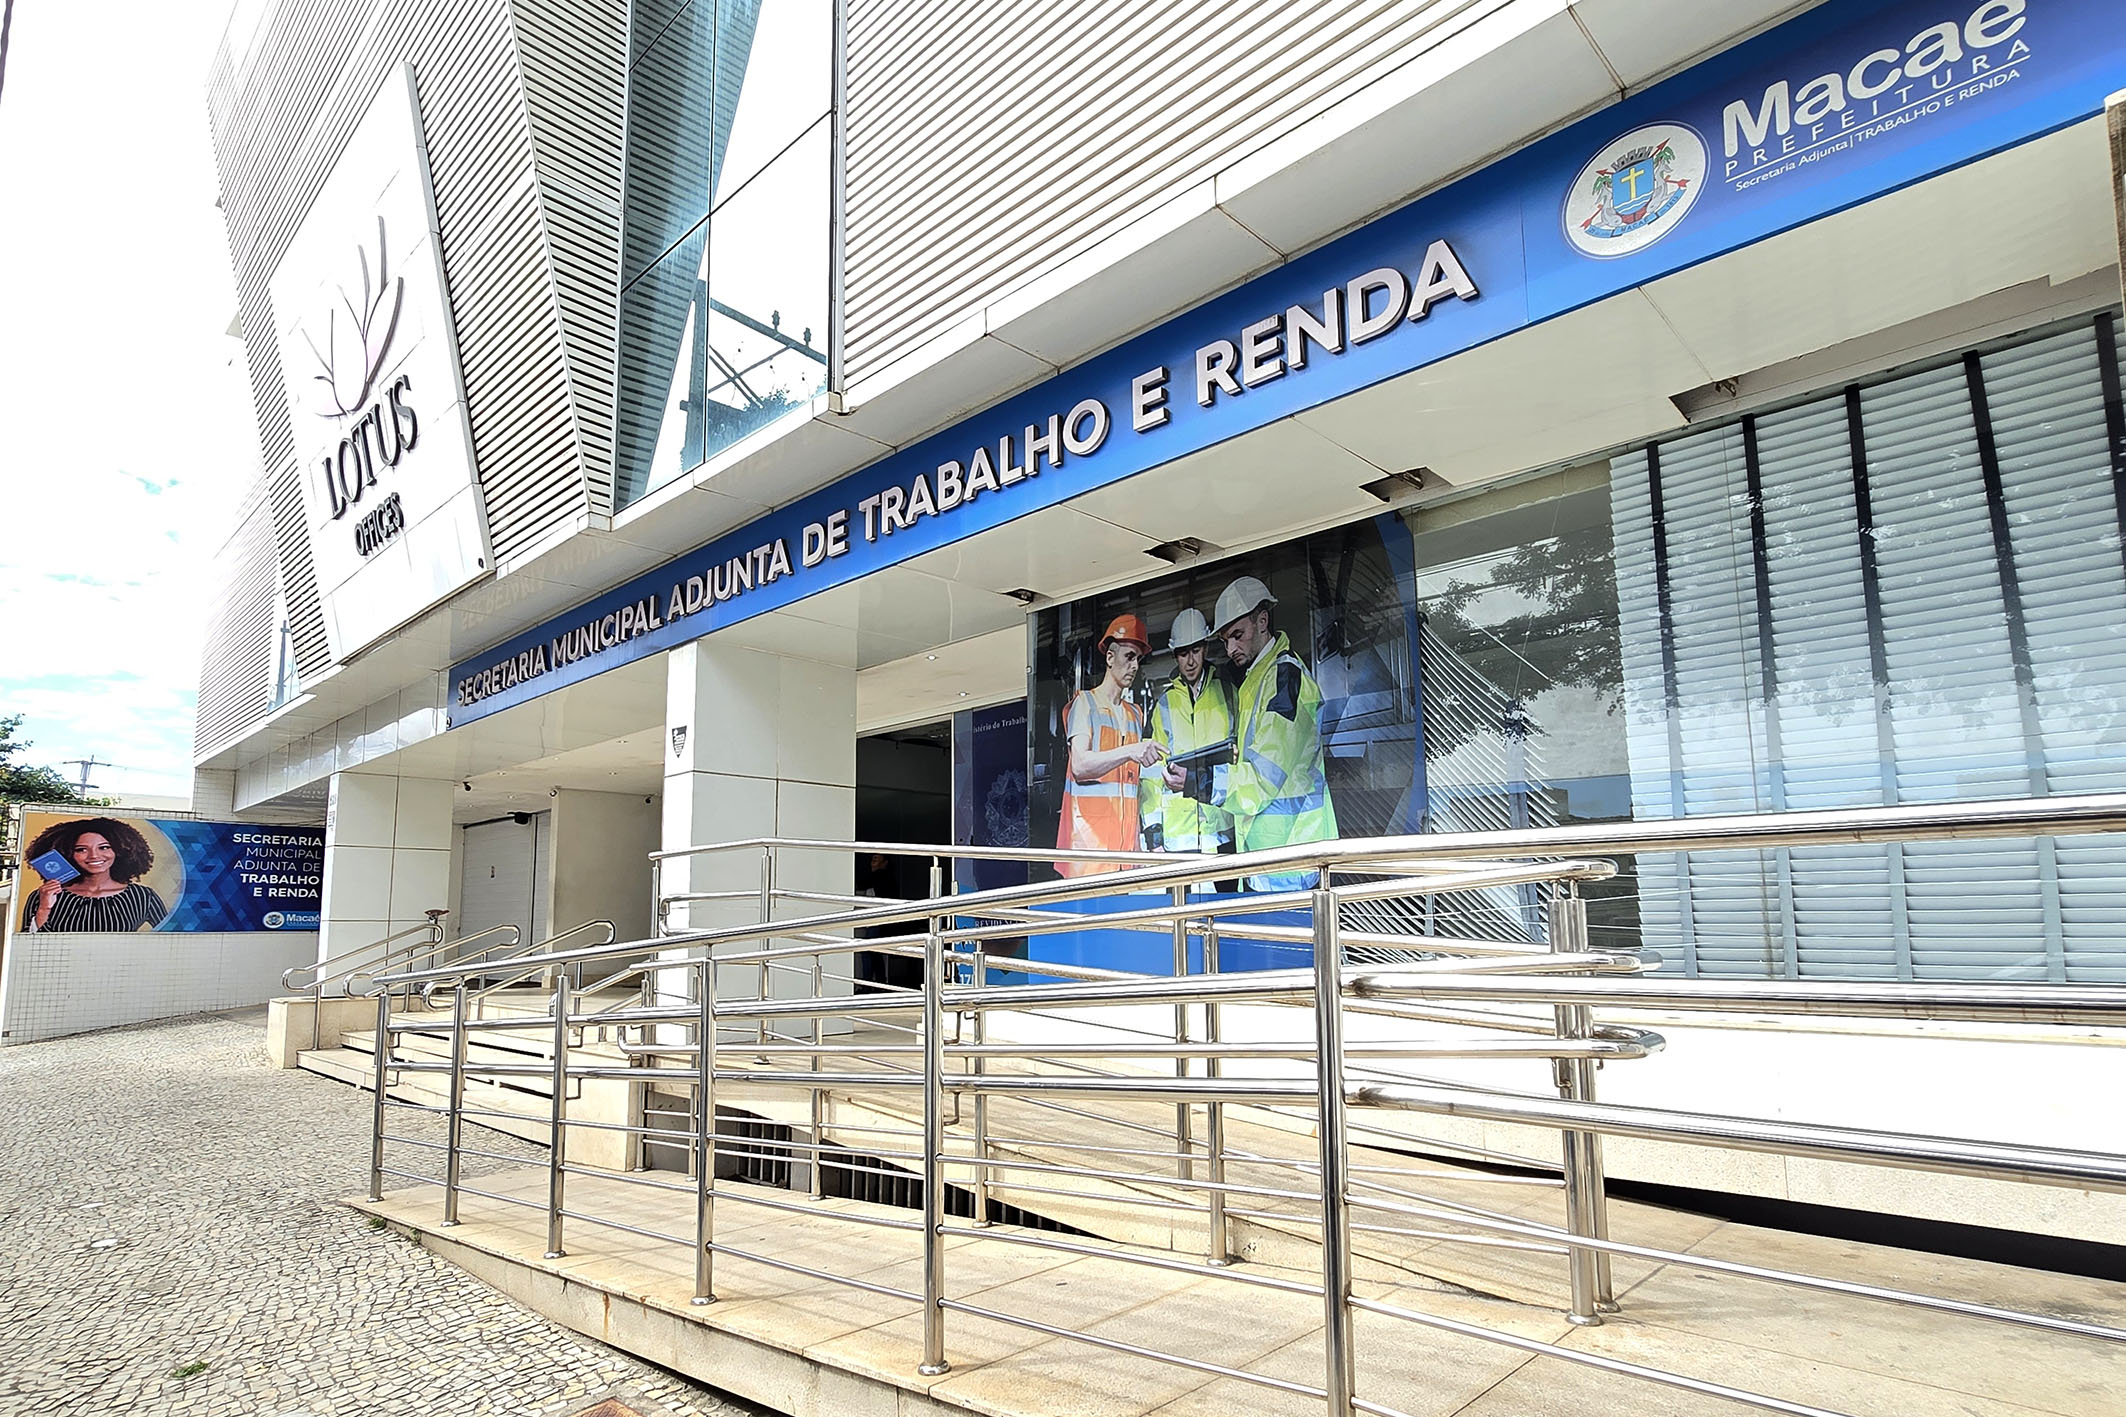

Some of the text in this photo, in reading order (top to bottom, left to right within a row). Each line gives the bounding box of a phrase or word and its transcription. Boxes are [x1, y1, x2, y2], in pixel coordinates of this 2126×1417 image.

[1724, 39, 2030, 178] PREFEITURA
[1735, 161, 1796, 192] Secretaria
[1798, 138, 1849, 166] Adjunta
[1854, 101, 1941, 143] TRABALHO
[1944, 94, 1955, 108] E
[1958, 69, 2020, 102] RENDA
[322, 374, 418, 520] LOTUS
[457, 645, 548, 707] SECRETARIA
[552, 595, 664, 670] MUNICIPAL
[667, 538, 793, 623] ADJUNTA
[802, 509, 849, 568] DE
[858, 398, 1112, 543] TRABALHO
[1132, 366, 1170, 434] E
[1195, 239, 1480, 407] RENDA
[354, 492, 405, 556] OFFICES
[232, 833, 323, 847] SECRETARIA
[246, 847, 321, 860] MUNICIPAL
[233, 860, 321, 873] ADJUNTA DE
[240, 873, 319, 885] TRABALHO
[253, 887, 318, 898] E RENDA
